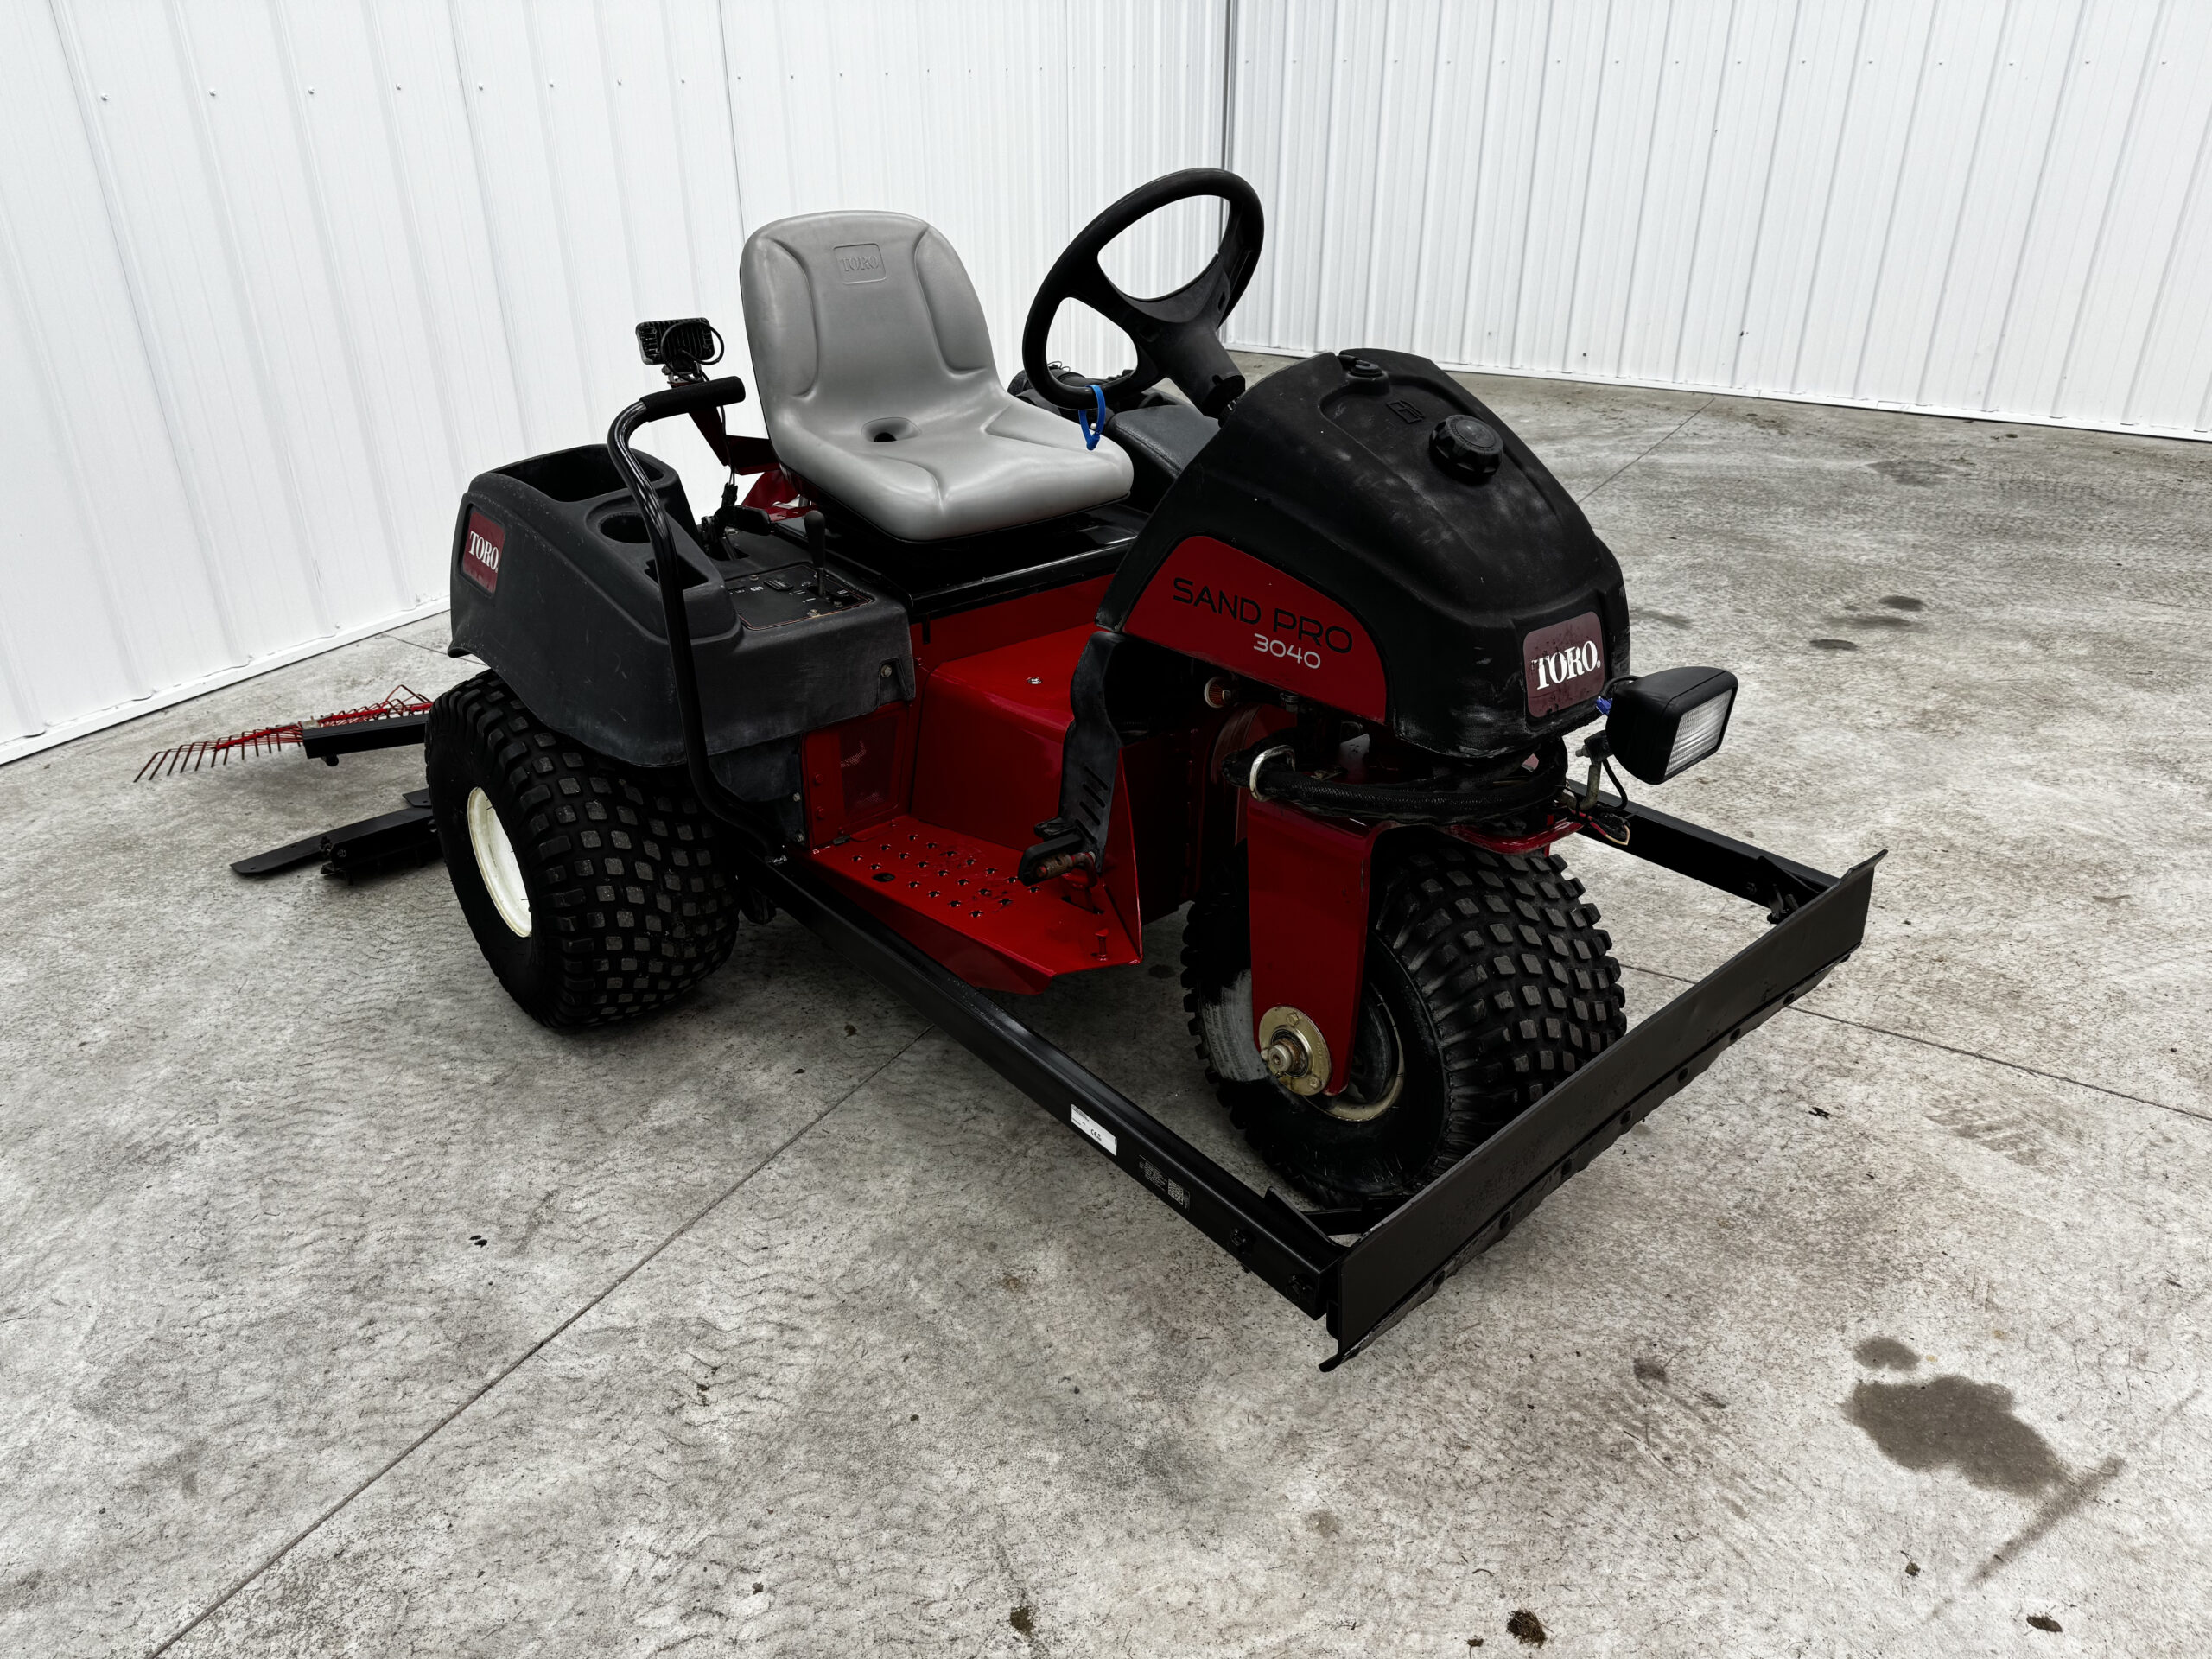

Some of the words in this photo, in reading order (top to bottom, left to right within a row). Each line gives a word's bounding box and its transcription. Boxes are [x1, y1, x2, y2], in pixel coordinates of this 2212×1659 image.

[838, 256, 880, 272] TORO
[469, 530, 499, 571] TORO
[1173, 576, 1262, 625] SAND
[1273, 607, 1353, 654] PRO
[1253, 632, 1321, 670] 3040
[1531, 640, 1598, 690] TORO
